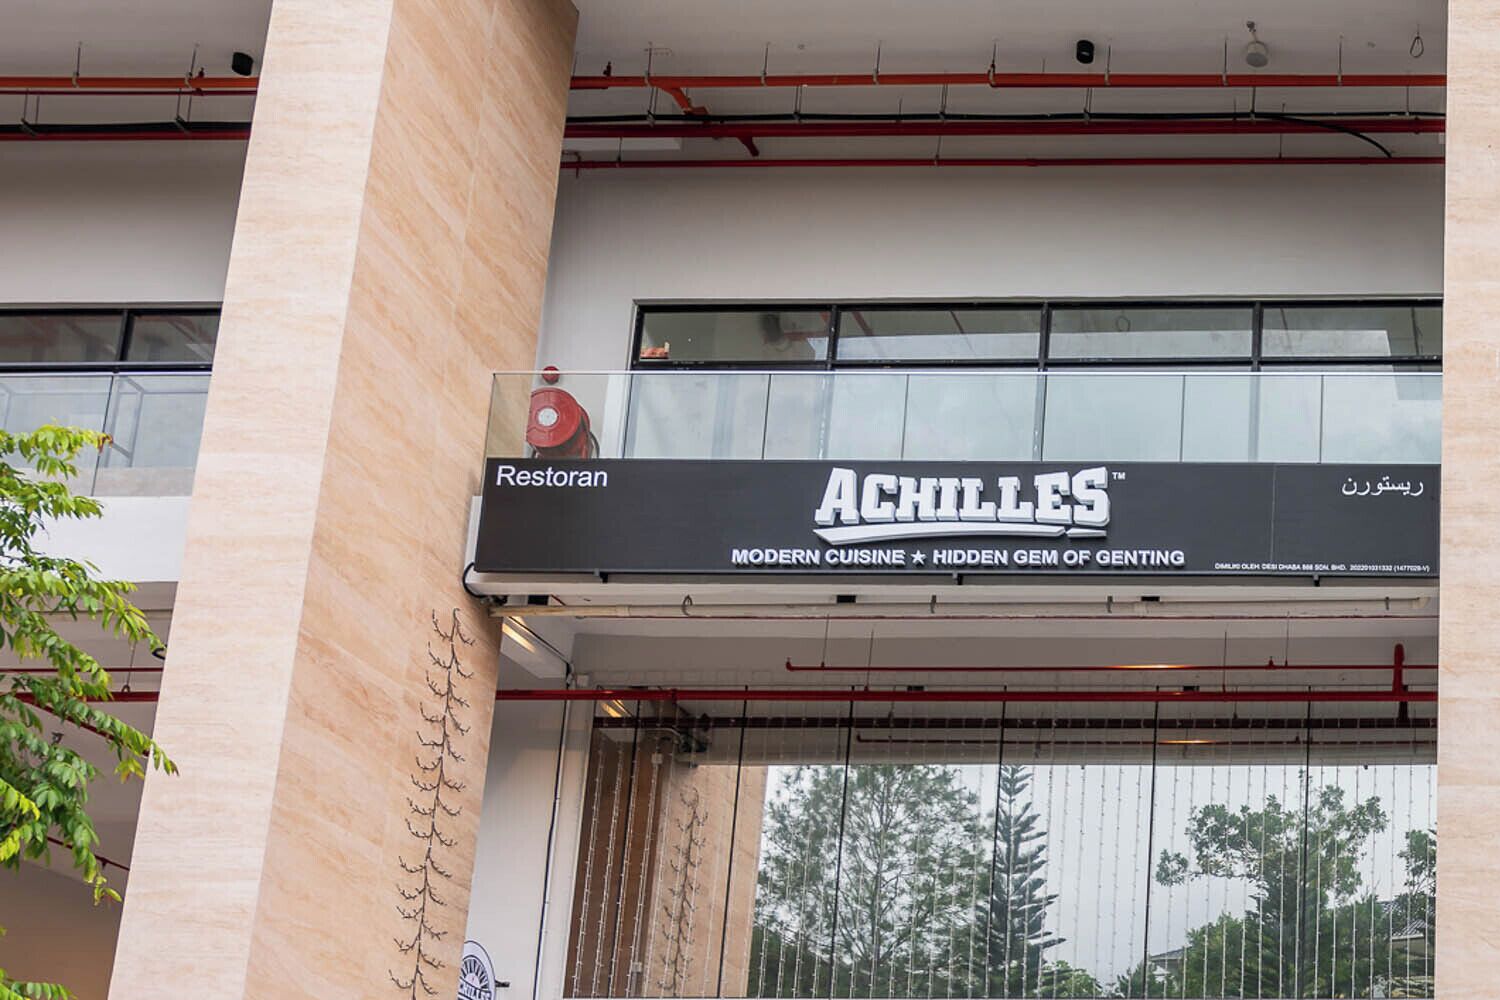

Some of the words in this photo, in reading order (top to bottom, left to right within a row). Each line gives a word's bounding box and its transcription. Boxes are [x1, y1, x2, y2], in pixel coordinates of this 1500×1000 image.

[495, 465, 608, 488] Restoran
[814, 467, 1111, 527] ACHILLES
[731, 548, 820, 567] MODERN
[824, 548, 906, 567] CUISINE
[932, 549, 1009, 567] HIDDEN
[1013, 550, 1059, 567] GEM
[1063, 550, 1091, 567] OF
[1095, 549, 1186, 568] GENTING
